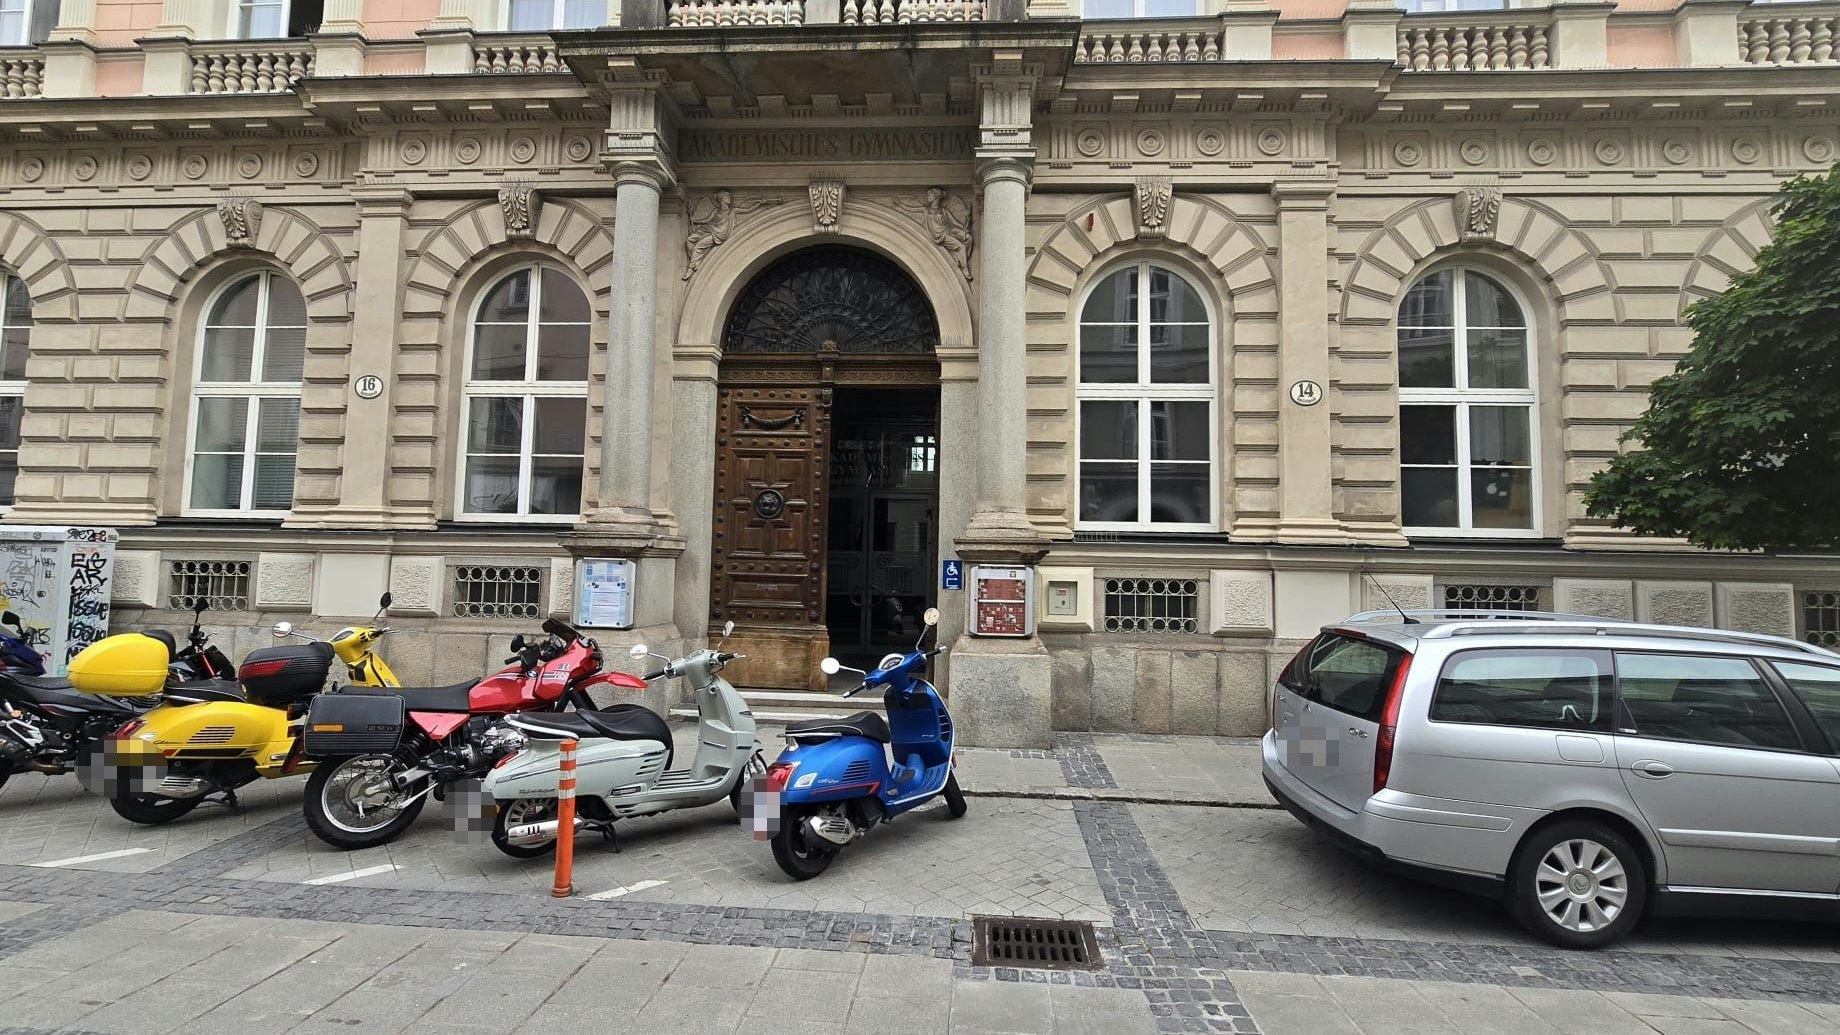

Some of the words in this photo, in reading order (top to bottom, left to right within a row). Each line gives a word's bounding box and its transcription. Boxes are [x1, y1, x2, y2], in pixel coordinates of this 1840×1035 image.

[690, 133, 839, 158] AKADEMISCHES
[848, 132, 971, 156] GYMNASIUM
[362, 377, 376, 391] 16
[1298, 382, 1314, 397] 14
